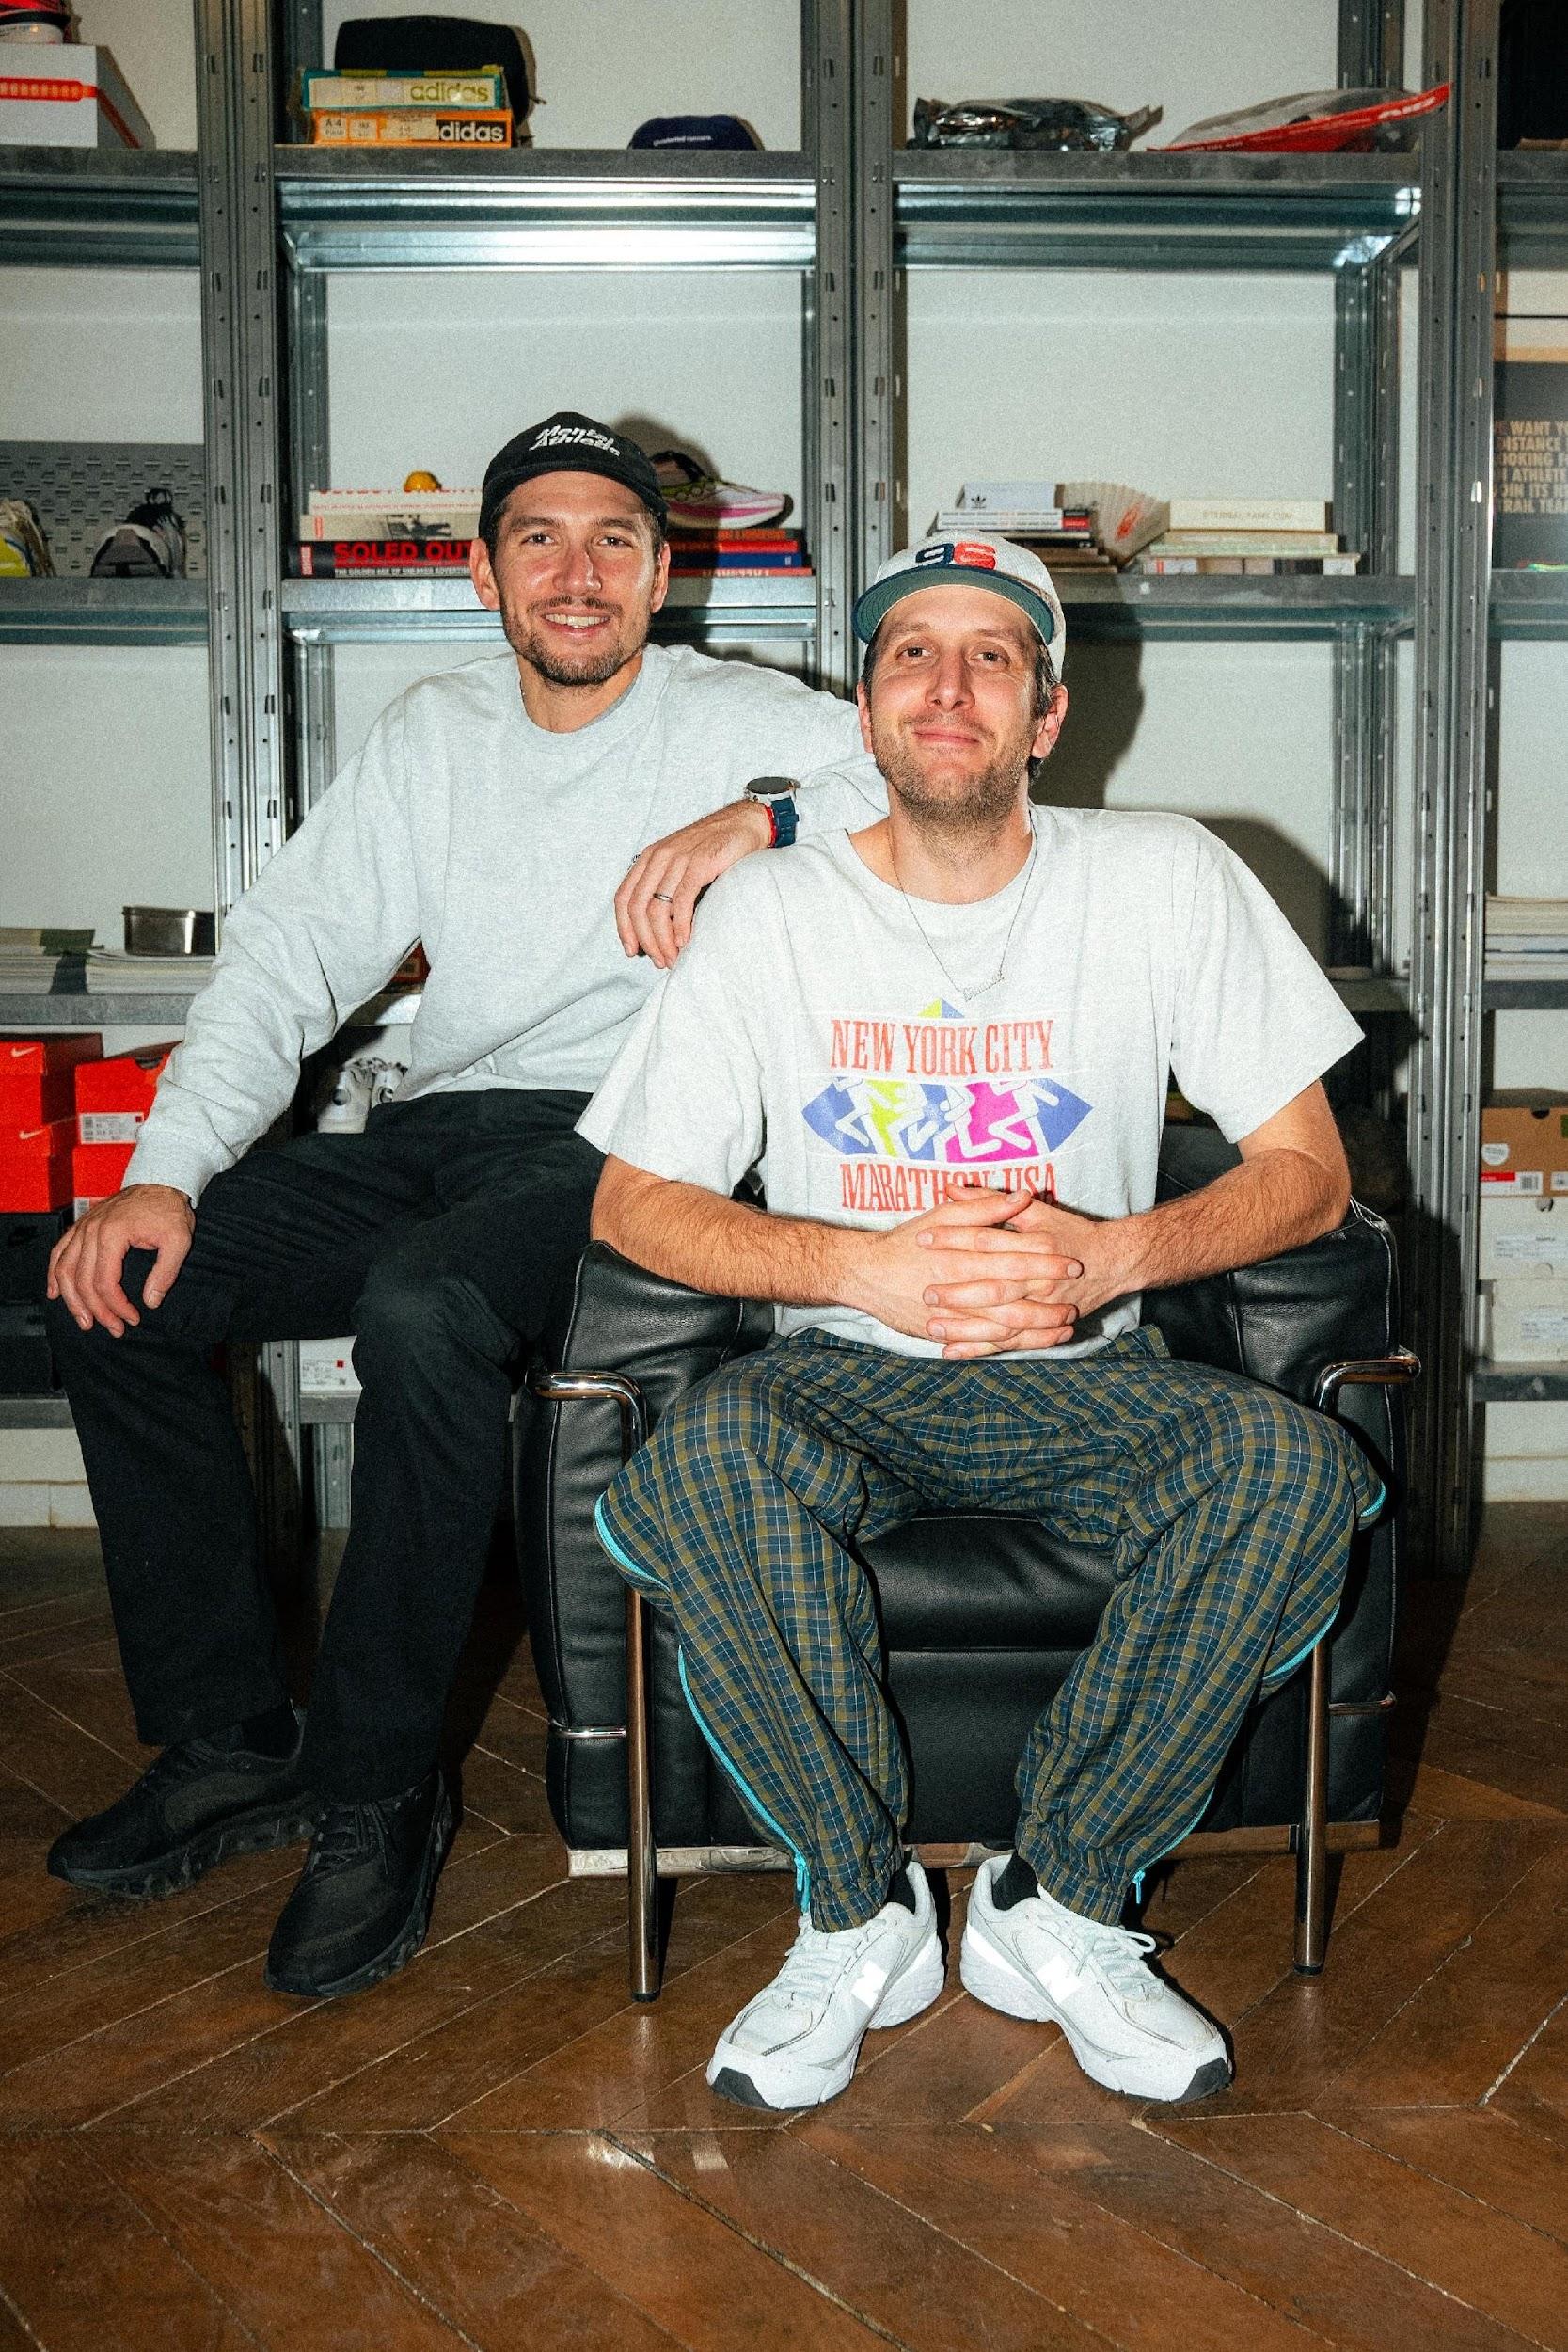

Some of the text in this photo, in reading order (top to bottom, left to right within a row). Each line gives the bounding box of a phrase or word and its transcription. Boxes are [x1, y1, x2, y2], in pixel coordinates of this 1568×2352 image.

[410, 82, 489, 103] adidas
[436, 121, 504, 141] didas
[334, 541, 419, 560] SOLED
[830, 1019, 1054, 1077] NEW YORK CITY
